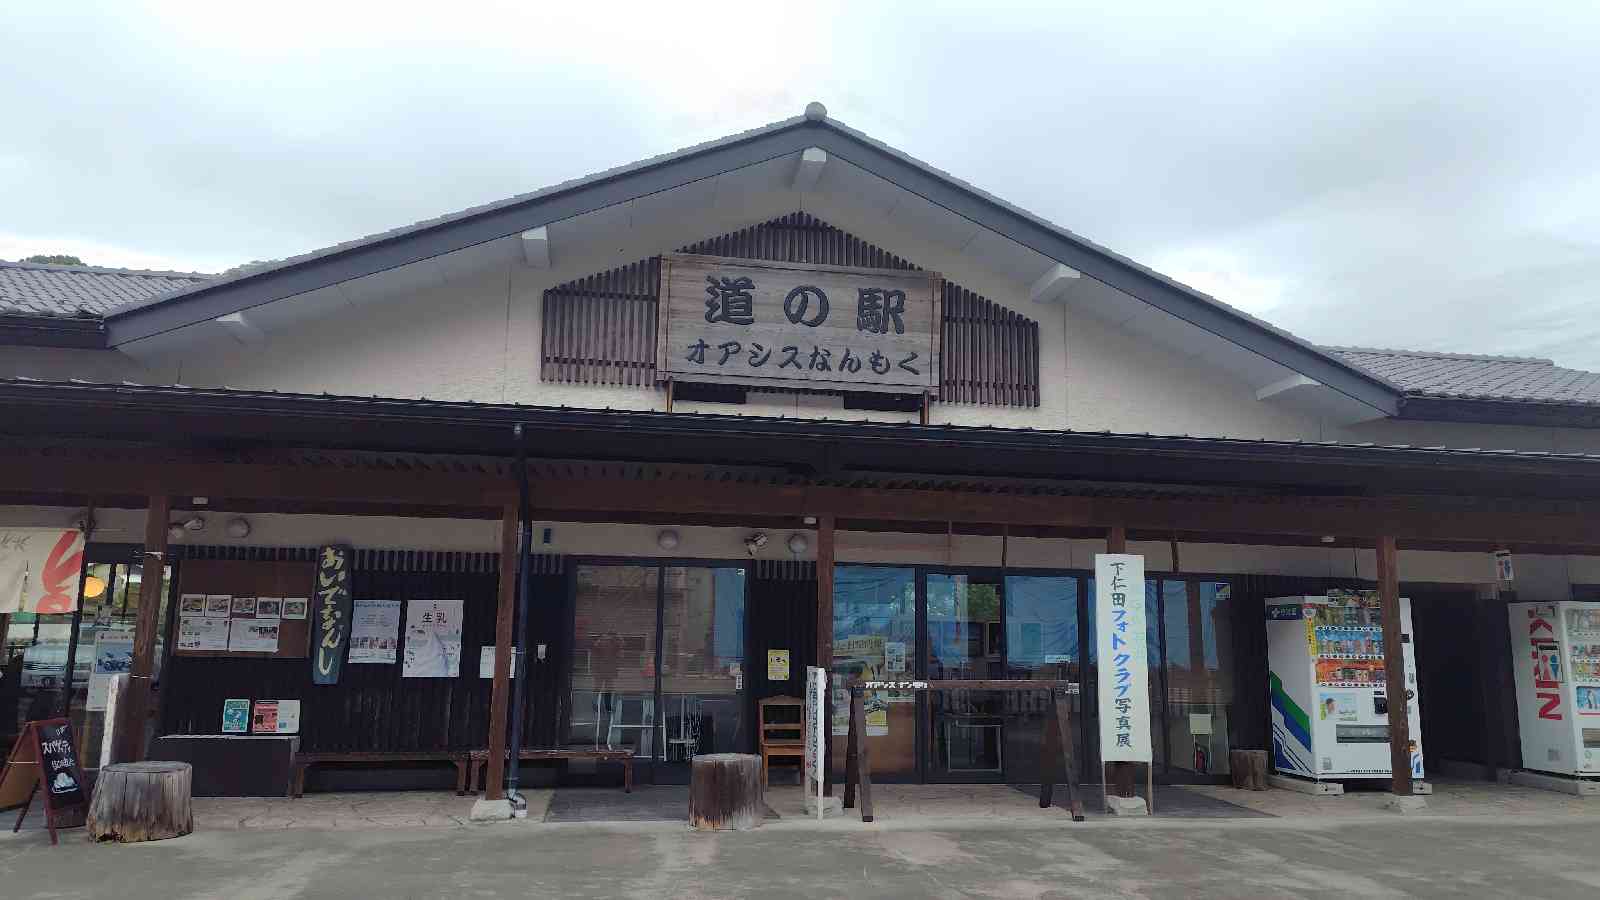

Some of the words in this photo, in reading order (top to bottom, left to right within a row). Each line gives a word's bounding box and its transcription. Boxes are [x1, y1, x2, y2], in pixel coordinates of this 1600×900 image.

[704, 275, 907, 334] 道の駅
[687, 338, 920, 375] オアシスなんもく
[422, 610, 447, 624] 生乳
[1109, 562, 1132, 748] 下仁田フォトクラブ写真展
